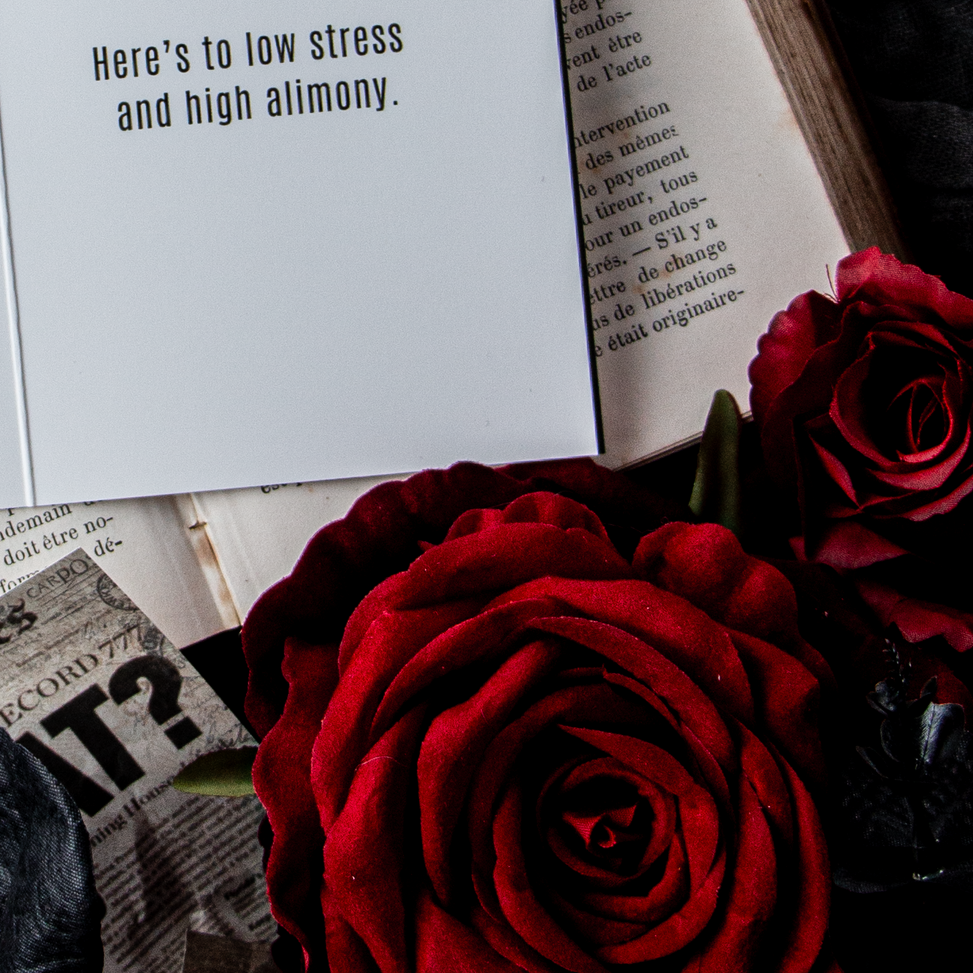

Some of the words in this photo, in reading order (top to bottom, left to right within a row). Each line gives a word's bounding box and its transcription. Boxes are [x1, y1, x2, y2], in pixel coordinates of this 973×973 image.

[93, 40, 190, 81] Here's
[202, 36, 232, 70] to
[246, 32, 295, 66] low
[309, 23, 403, 60] stress
[575, 12, 632, 39] endos-
[577, 74, 598, 92] de
[602, 55, 651, 82] l'acte
[117, 92, 172, 131] and
[185, 85, 252, 126] high
[267, 77, 398, 117] alimony.
[574, 102, 671, 148] ntervention
[579, 183, 598, 199] le
[603, 145, 689, 195] payement
[585, 150, 614, 170] des
[595, 191, 653, 220] tireur,
[660, 171, 698, 194] tous
[585, 230, 614, 252] our
[618, 221, 644, 237] un
[648, 197, 707, 226] endos-
[588, 254, 627, 278] érés.
[689, 223, 700, 241] y
[705, 218, 718, 230] a
[590, 279, 627, 305] ettre
[638, 266, 659, 283] de
[665, 240, 727, 273] change
[614, 303, 635, 321] de
[640, 263, 736, 309] libérations
[608, 323, 649, 351] était
[652, 290, 744, 332] originaire-
[4, 541, 40, 566] doit
[43, 528, 78, 550] être
[83, 517, 113, 534] no-
